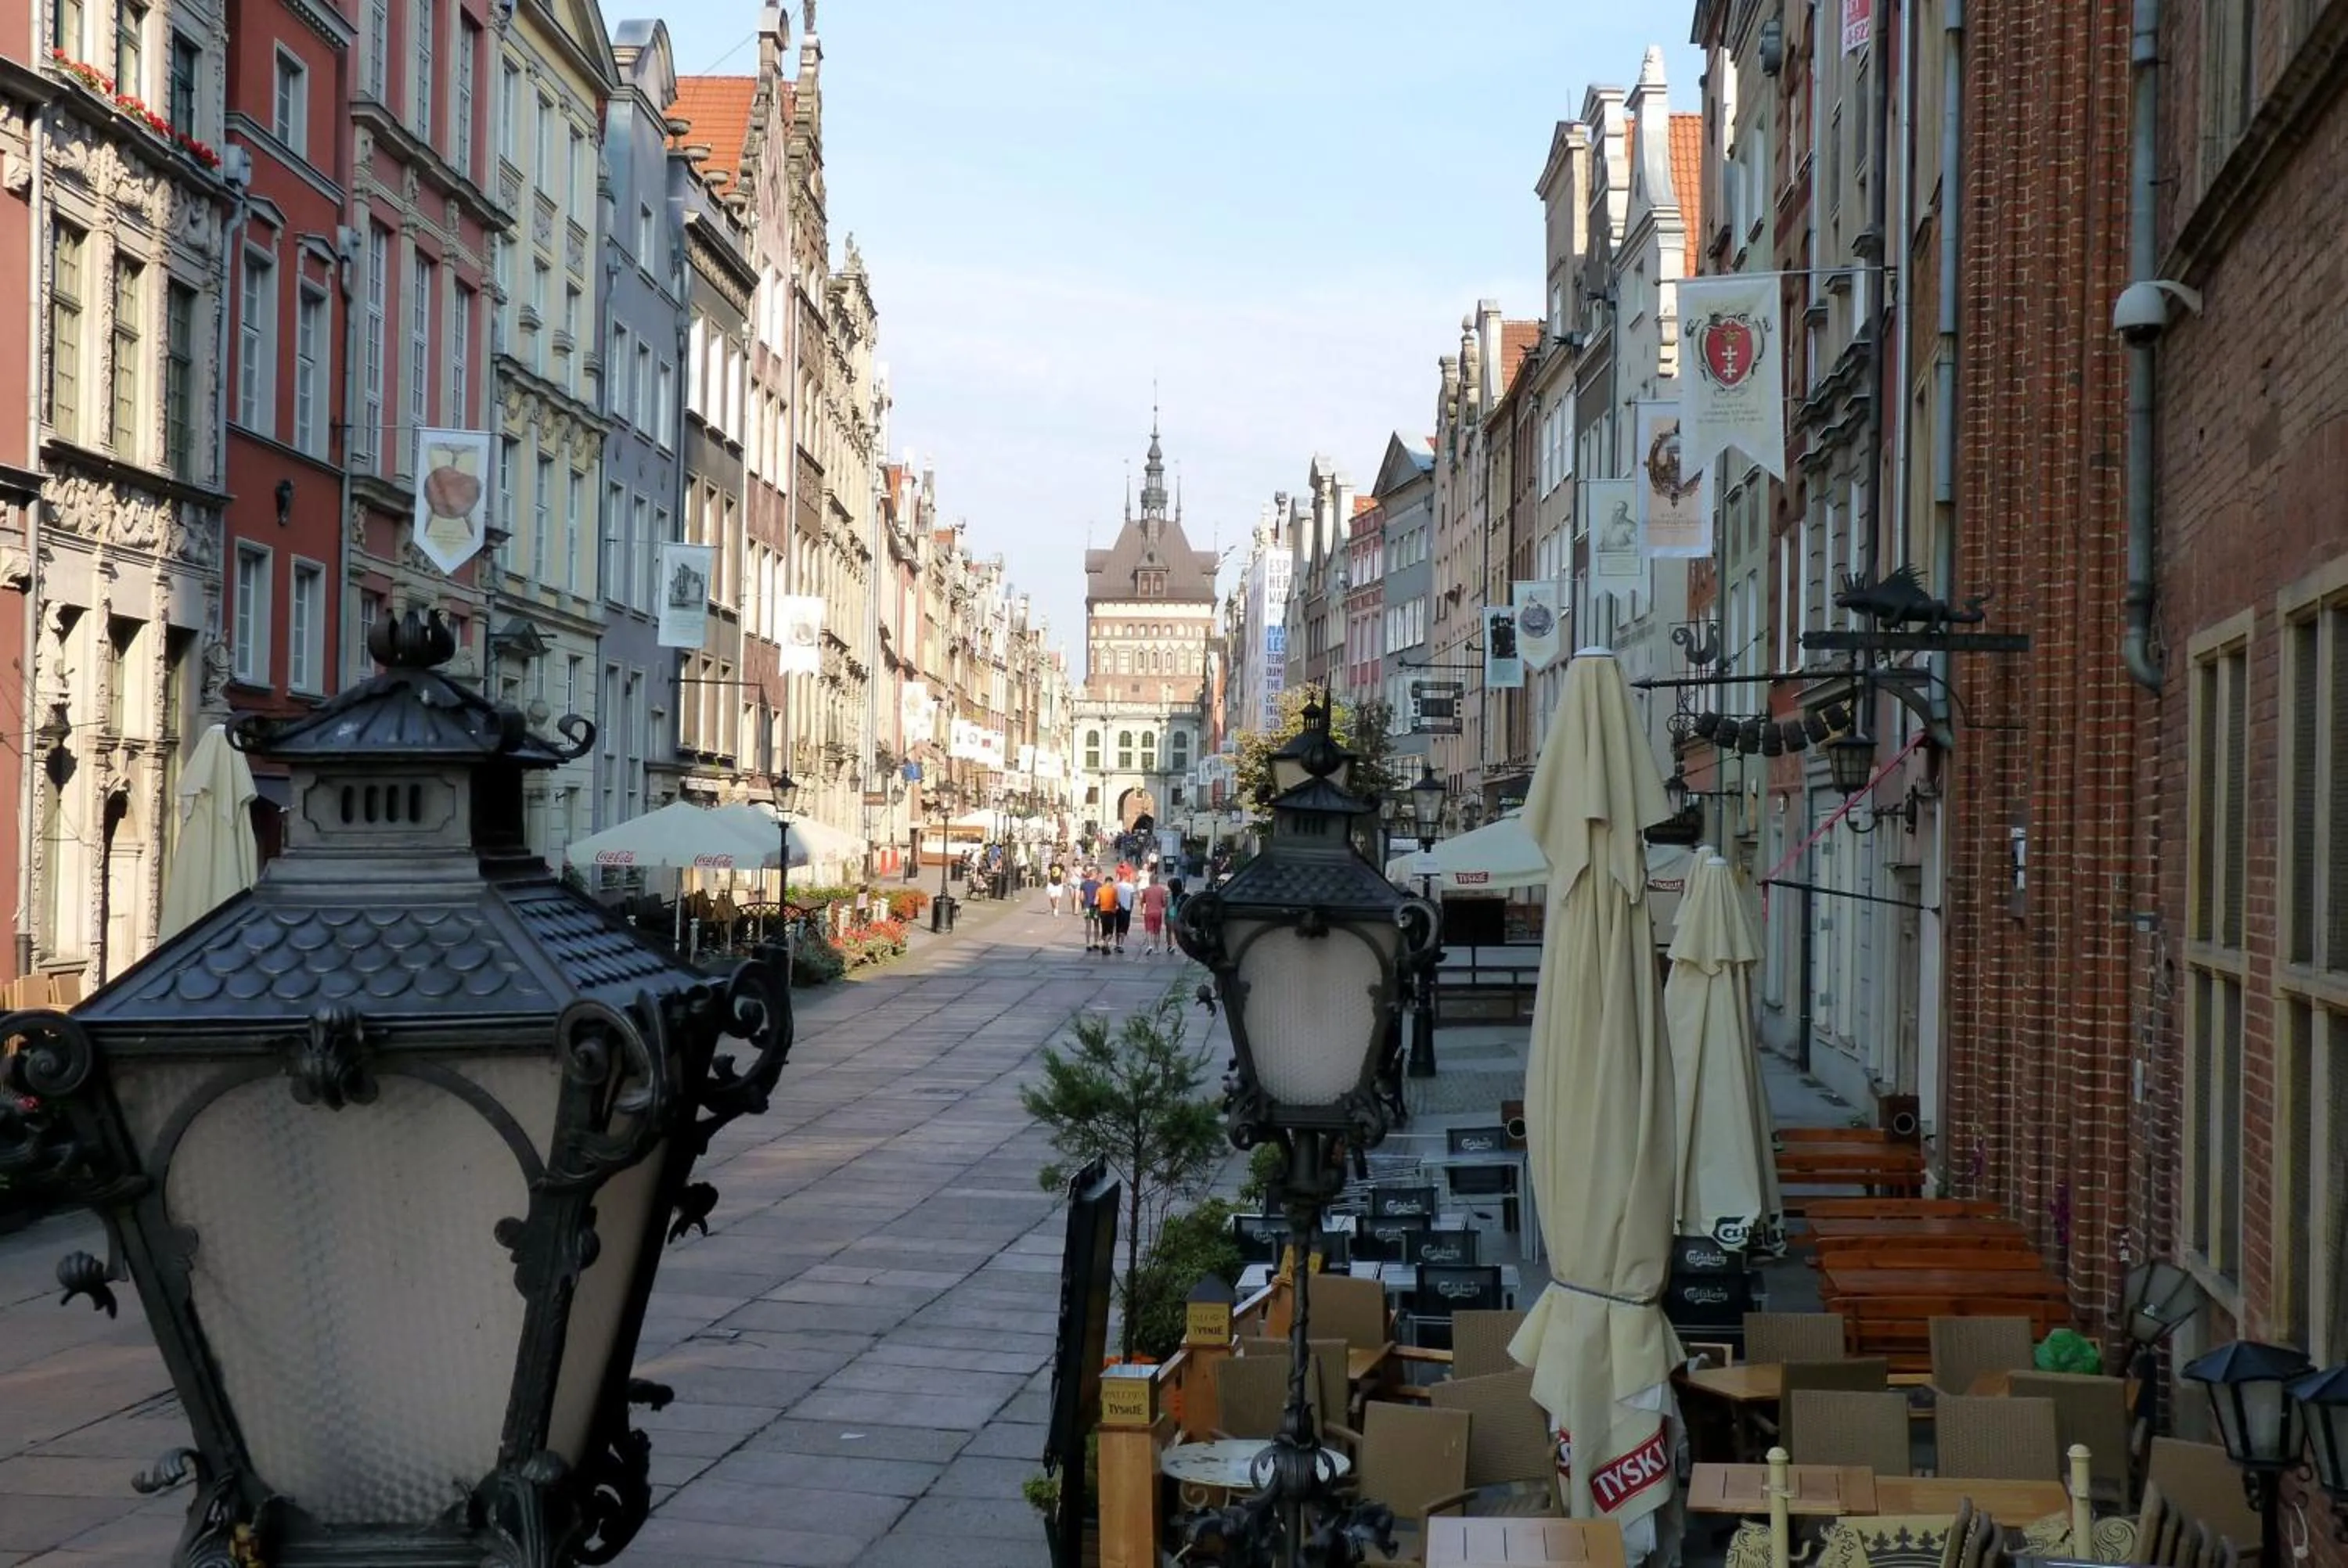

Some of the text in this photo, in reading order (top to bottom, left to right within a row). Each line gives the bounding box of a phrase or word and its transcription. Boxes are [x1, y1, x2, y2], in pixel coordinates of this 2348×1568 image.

[1686, 1250, 1727, 1267] Carlsberg
[1684, 1287, 1728, 1304] Carlsberg
[1594, 1435, 1668, 1501] TYSKI
